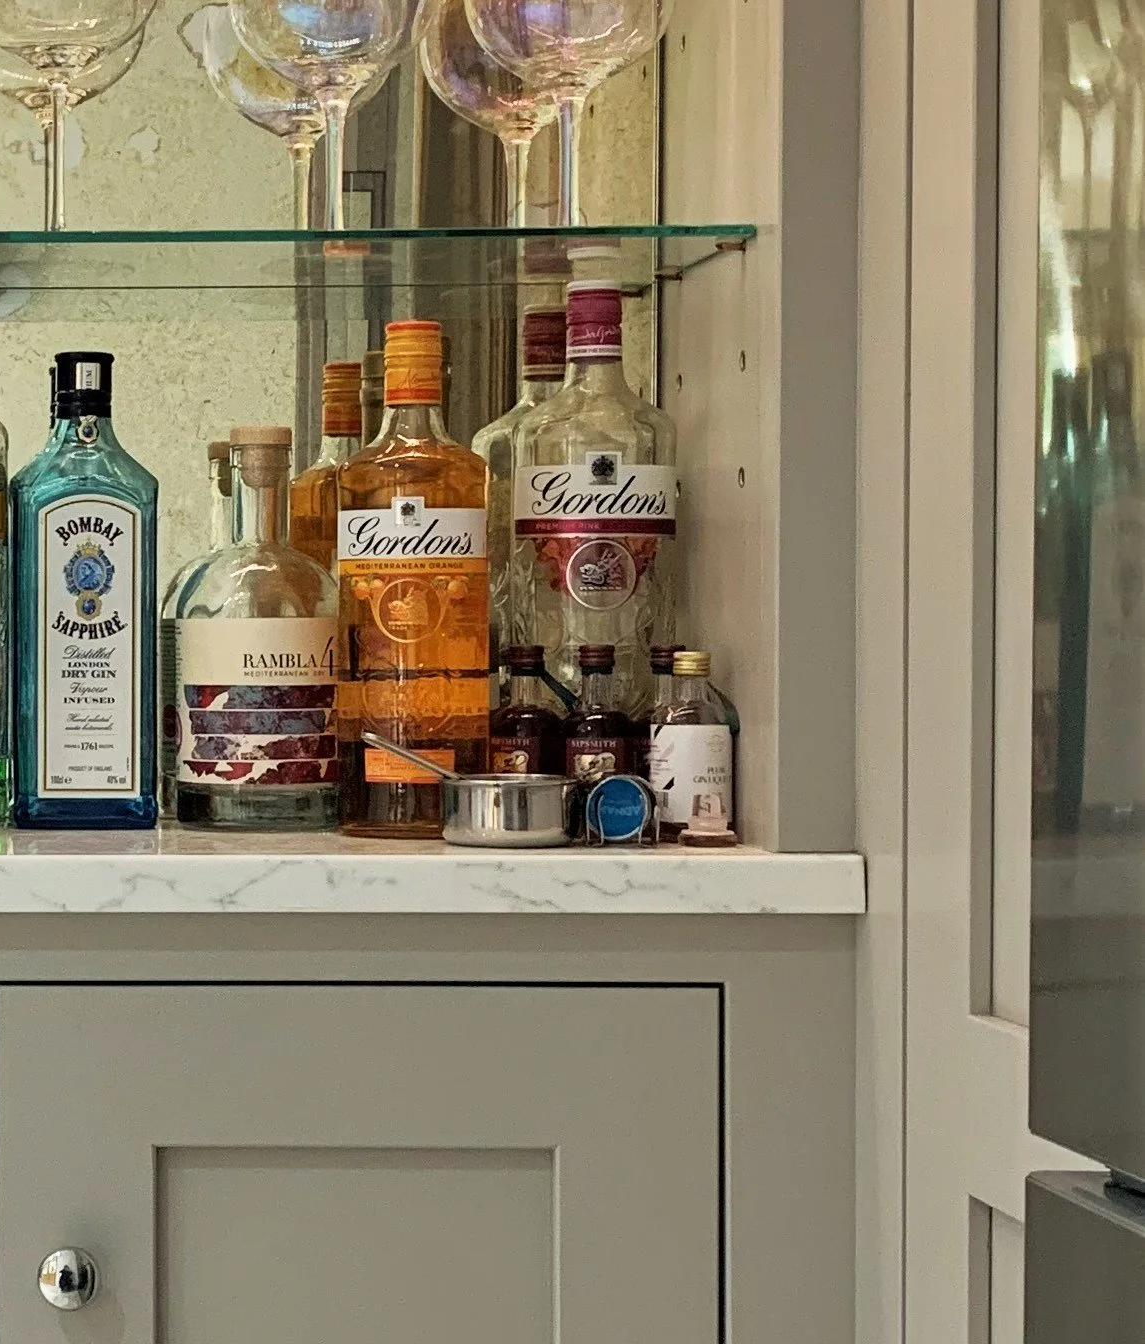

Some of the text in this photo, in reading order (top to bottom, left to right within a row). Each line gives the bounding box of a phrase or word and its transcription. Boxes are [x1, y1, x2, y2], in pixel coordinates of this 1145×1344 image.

[531, 471, 666, 516] Gordon's
[55, 516, 124, 546] BOMBAY
[347, 516, 473, 557] Gordon's
[355, 562, 464, 570] MEDITERRANEAN ORANGE
[51, 610, 125, 640] SAPPHIRE
[62, 644, 116, 660] Distilled
[242, 653, 318, 669] RAMBLA
[61, 669, 117, 678] DRY GIN
[69, 681, 108, 696] Vapour
[81, 741, 98, 750] 1761
[571, 739, 617, 748] SIPSMITH
